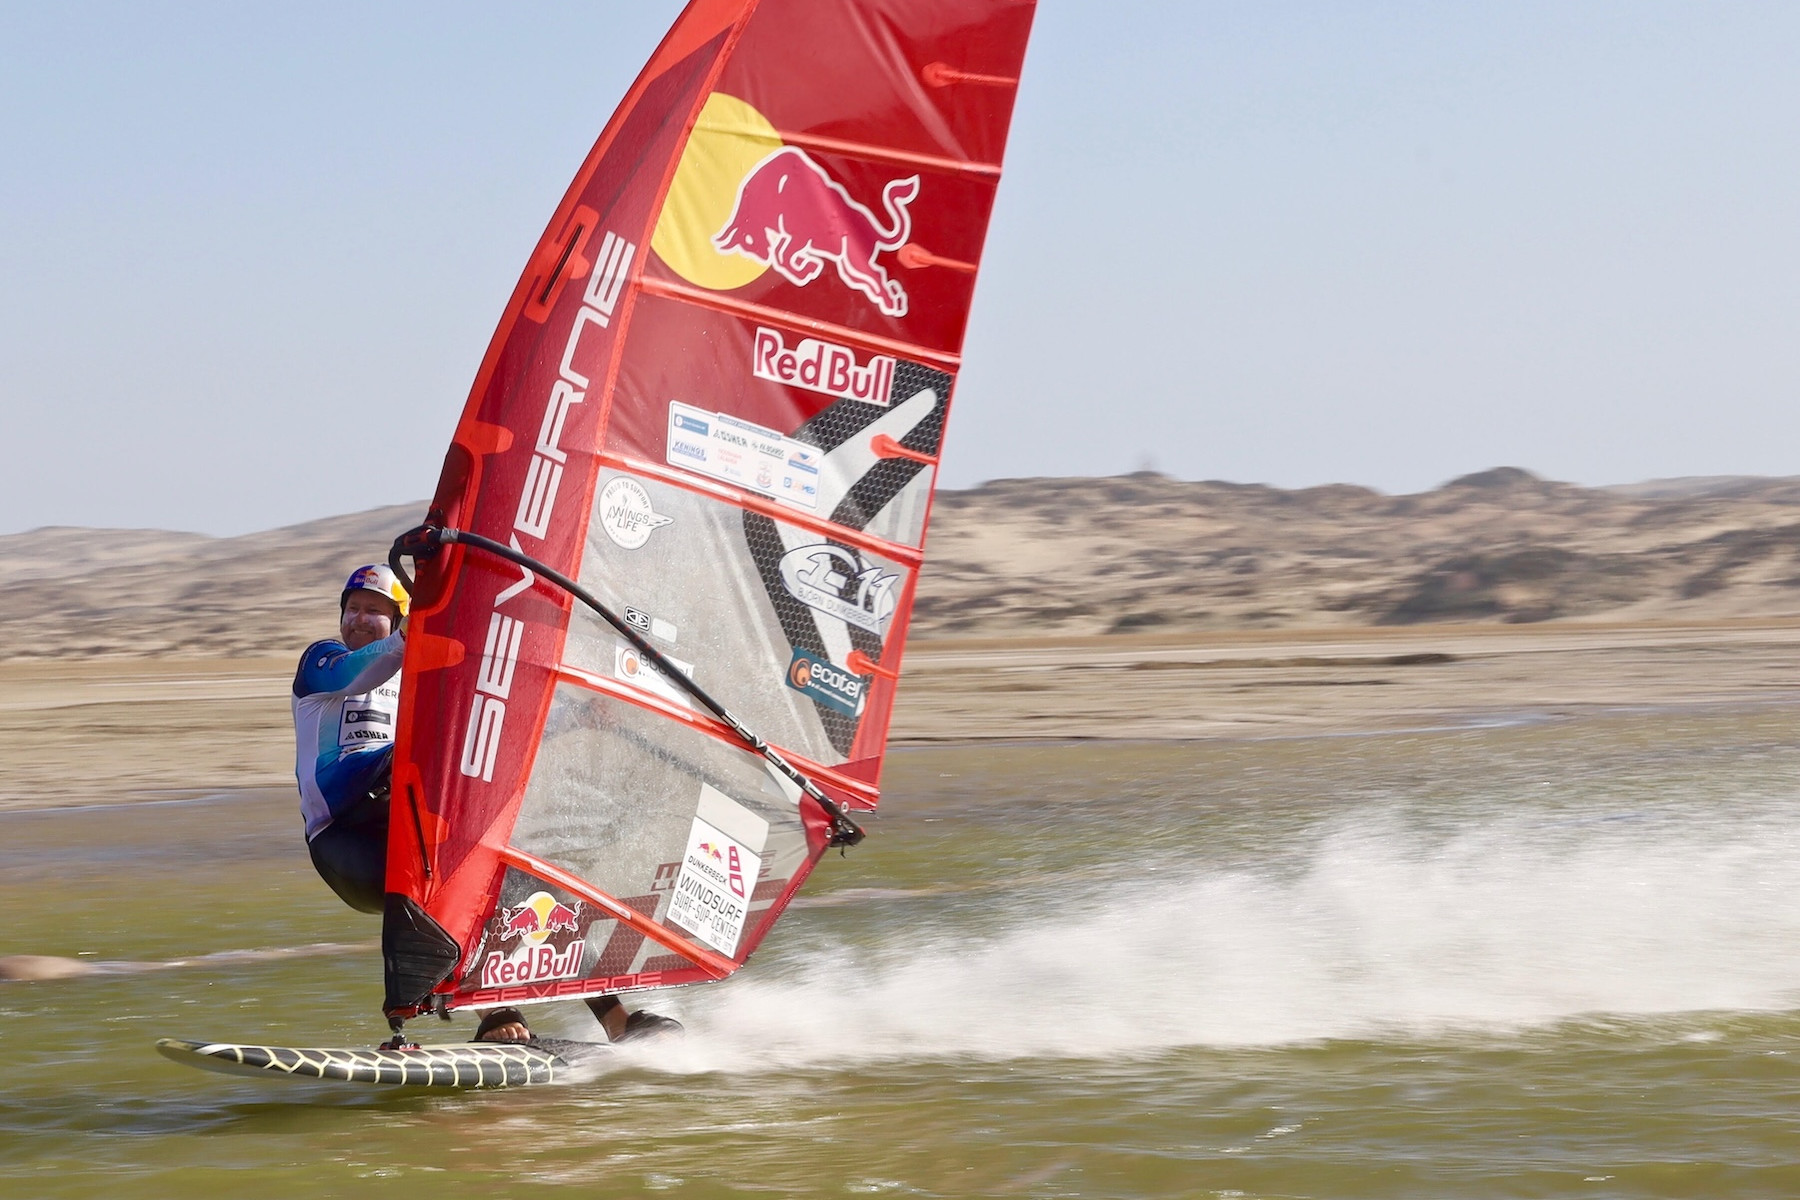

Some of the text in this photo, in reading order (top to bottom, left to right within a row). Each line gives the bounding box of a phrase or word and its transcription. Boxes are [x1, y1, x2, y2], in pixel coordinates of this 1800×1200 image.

[756, 333, 893, 403] Red Bull
[460, 230, 636, 783] SEVERNE
[610, 506, 650, 526] WINGS
[630, 483, 650, 509] SUPPORT
[810, 662, 863, 699] ecotel
[687, 855, 728, 886] DUNKERBECK
[674, 890, 738, 942] SURF-SUP-CENTER
[680, 873, 743, 922] WINDSURF
[483, 947, 534, 985] Red
[534, 942, 583, 979] Bull
[472, 971, 663, 1005] SEVERNE
